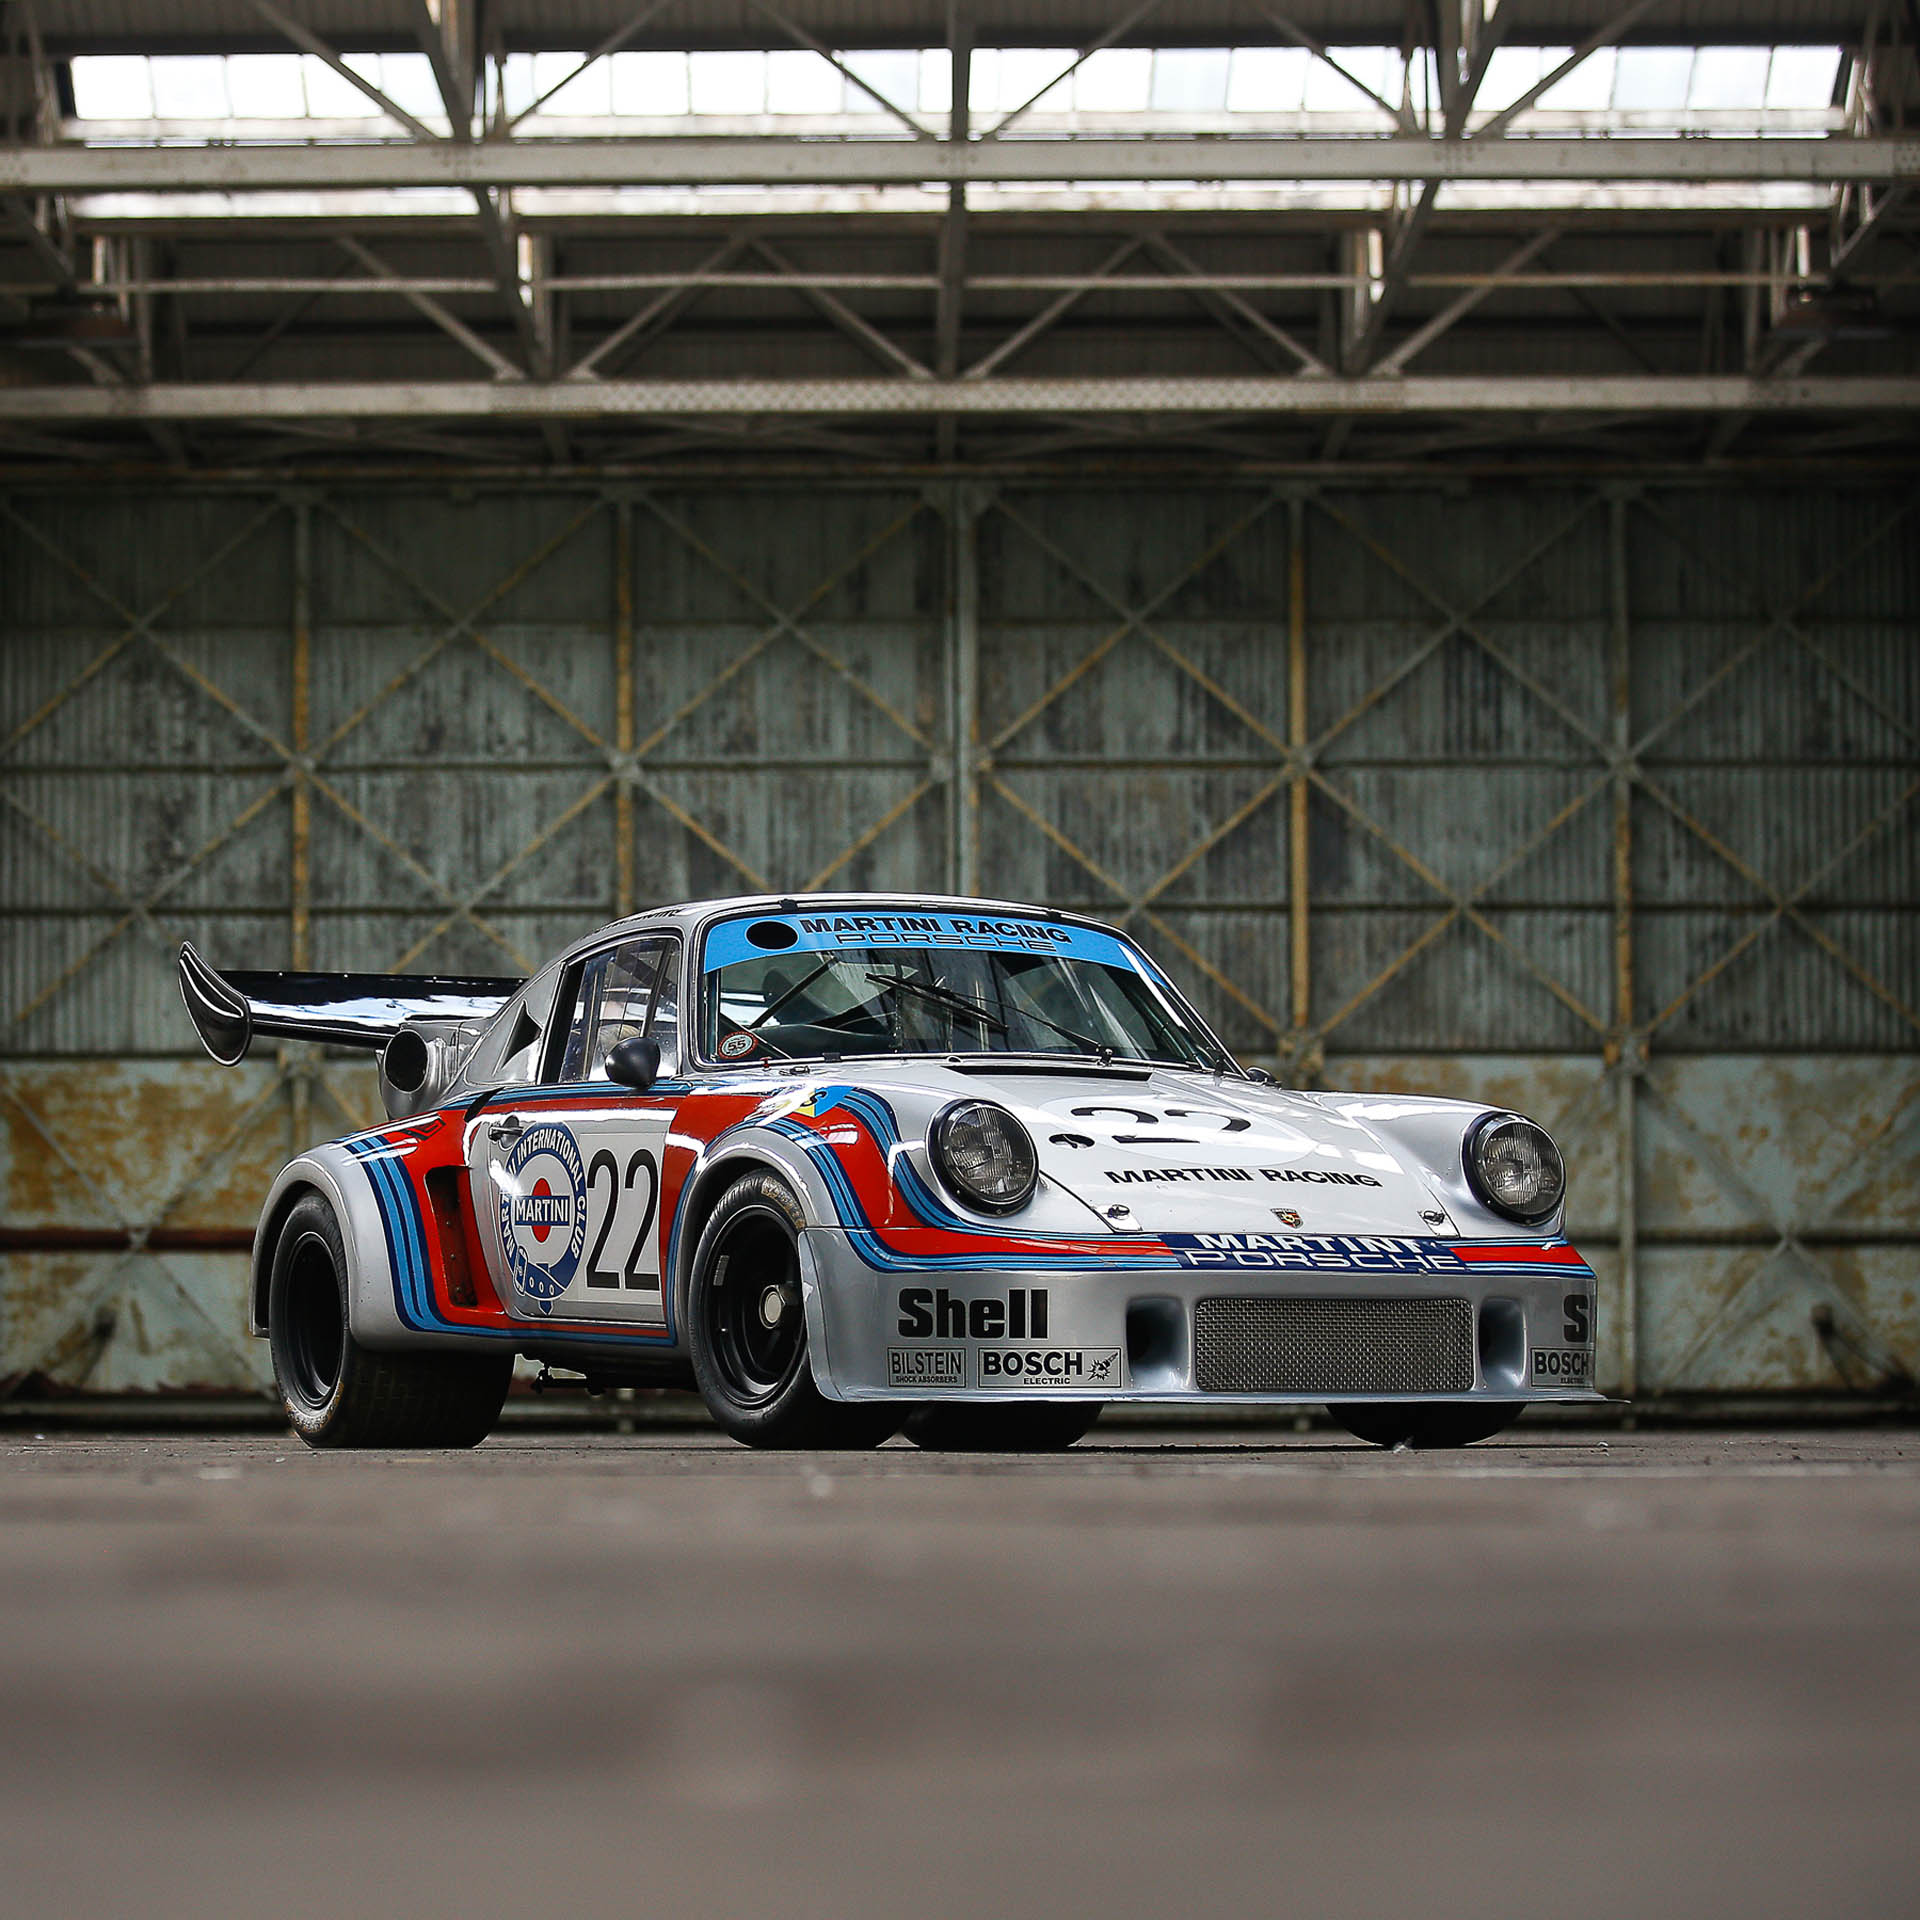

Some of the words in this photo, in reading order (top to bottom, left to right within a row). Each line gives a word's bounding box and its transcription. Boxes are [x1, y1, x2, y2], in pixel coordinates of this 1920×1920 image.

[799, 916, 943, 934] MARTINI
[948, 918, 1073, 944] RACING
[834, 933, 1058, 952] PORSCHE
[1103, 1168, 1255, 1184] MARTINI
[1258, 1169, 1384, 1188] RACING
[516, 1127, 583, 1192] INTERNATIONAL
[570, 1195, 586, 1260] CLUB
[515, 1198, 569, 1222] MARTINI
[586, 1148, 661, 1289] 22
[1184, 1249, 1466, 1271] PORSCHE
[897, 1287, 1050, 1339] Shell
[891, 1351, 962, 1375] BILSTEIN
[982, 1350, 1084, 1376] BOSCH
[1534, 1351, 1589, 1376] BOSCH
[895, 1375, 917, 1384] SHOCK
[918, 1375, 958, 1385] ABSORBERS
[1023, 1377, 1071, 1386] ELECTRIC
